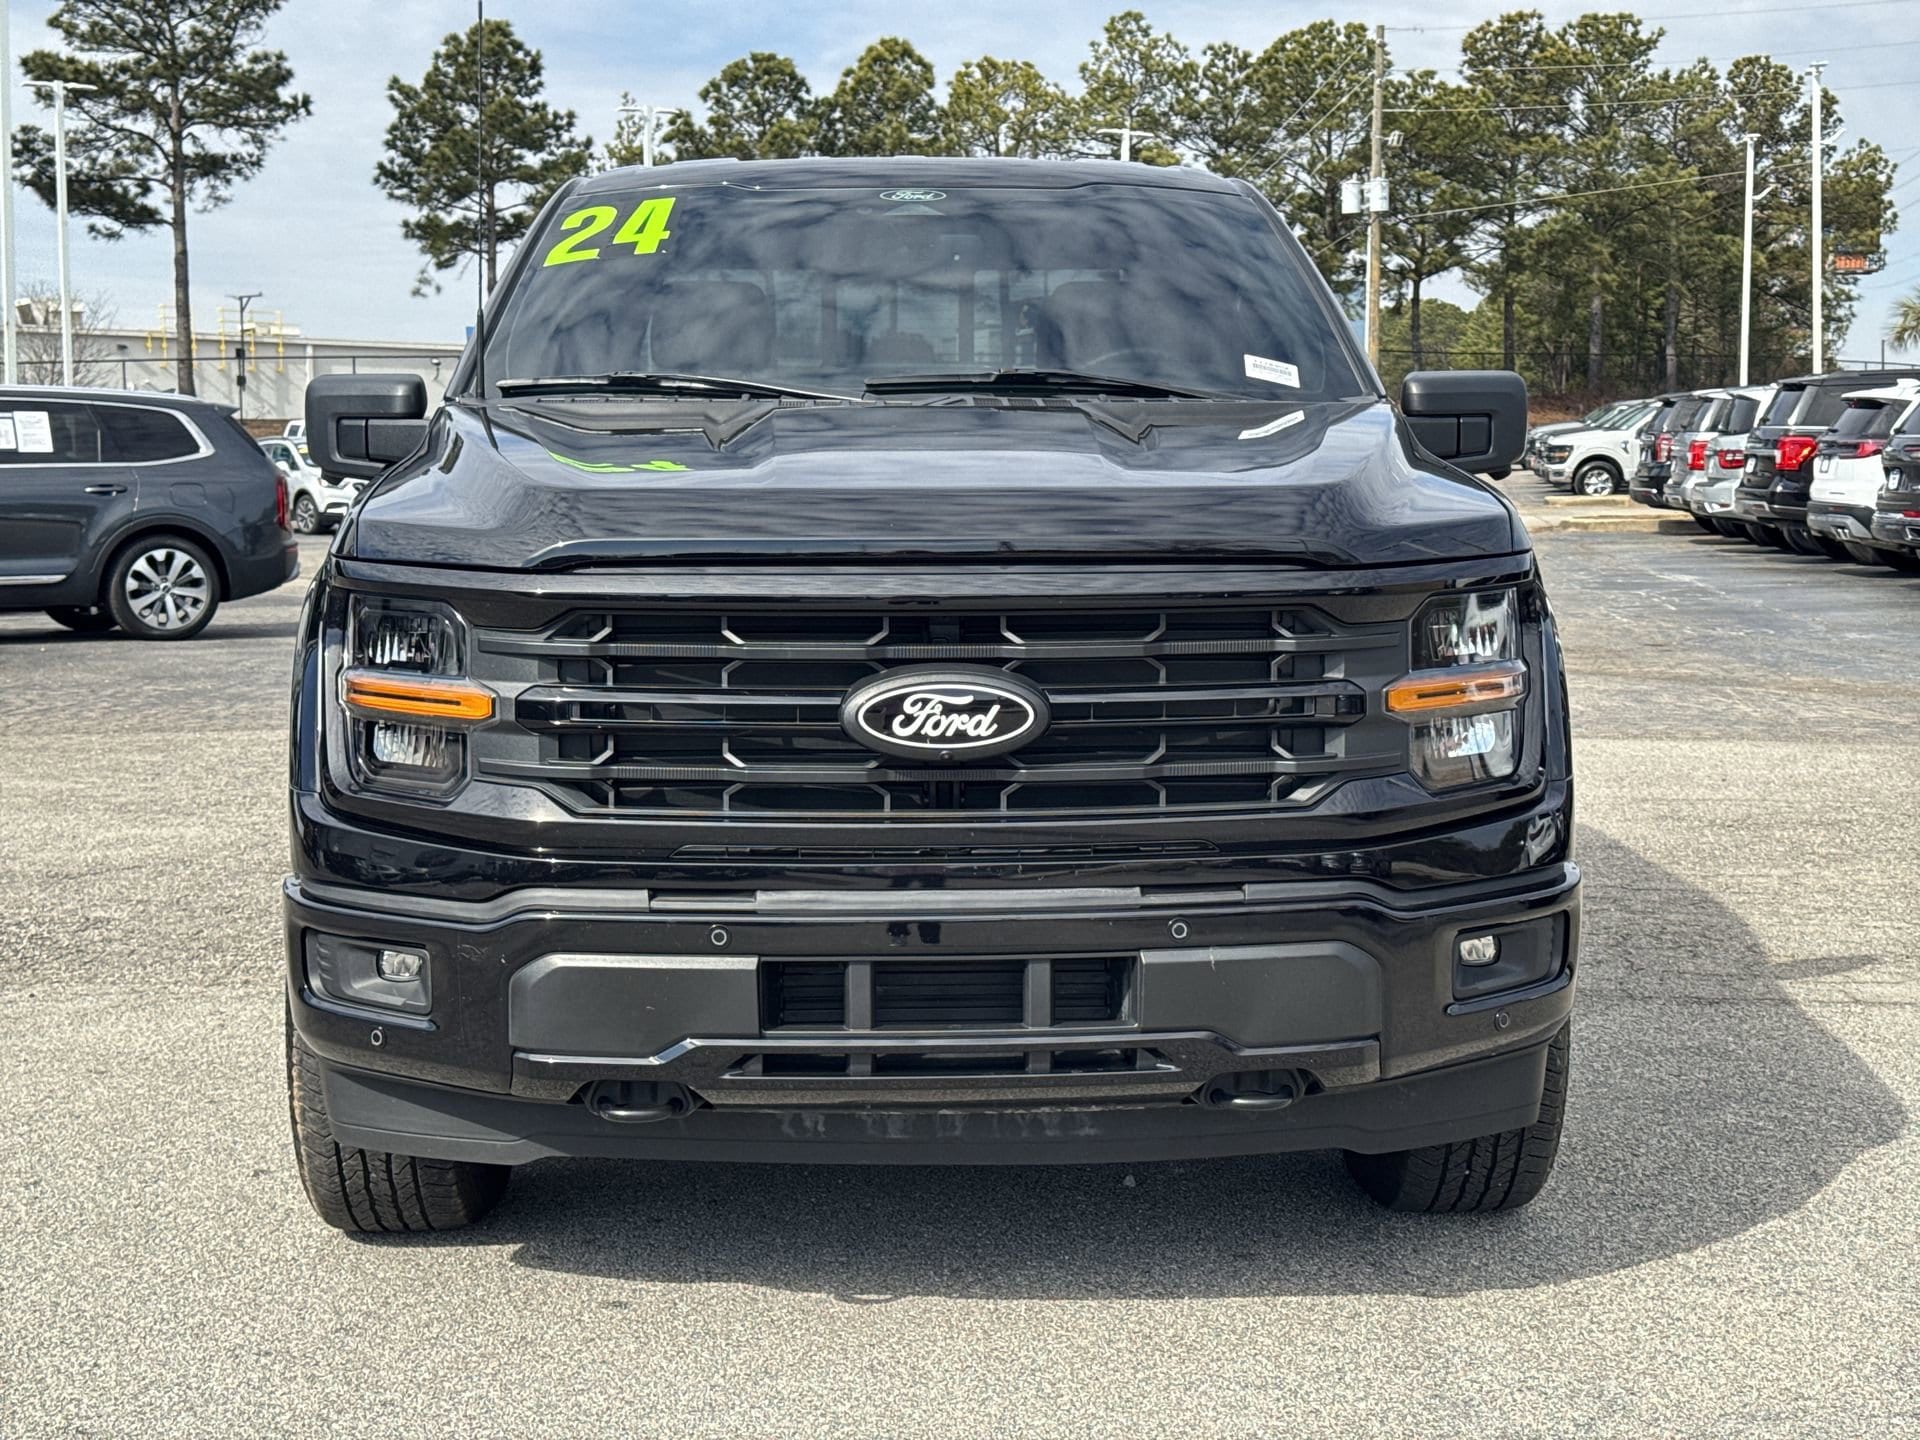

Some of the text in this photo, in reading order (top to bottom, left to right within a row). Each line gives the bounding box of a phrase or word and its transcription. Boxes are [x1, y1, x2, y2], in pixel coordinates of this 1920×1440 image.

[891, 190, 935, 200] Ford
[543, 197, 676, 267] 24
[891, 693, 1001, 737] Ford
